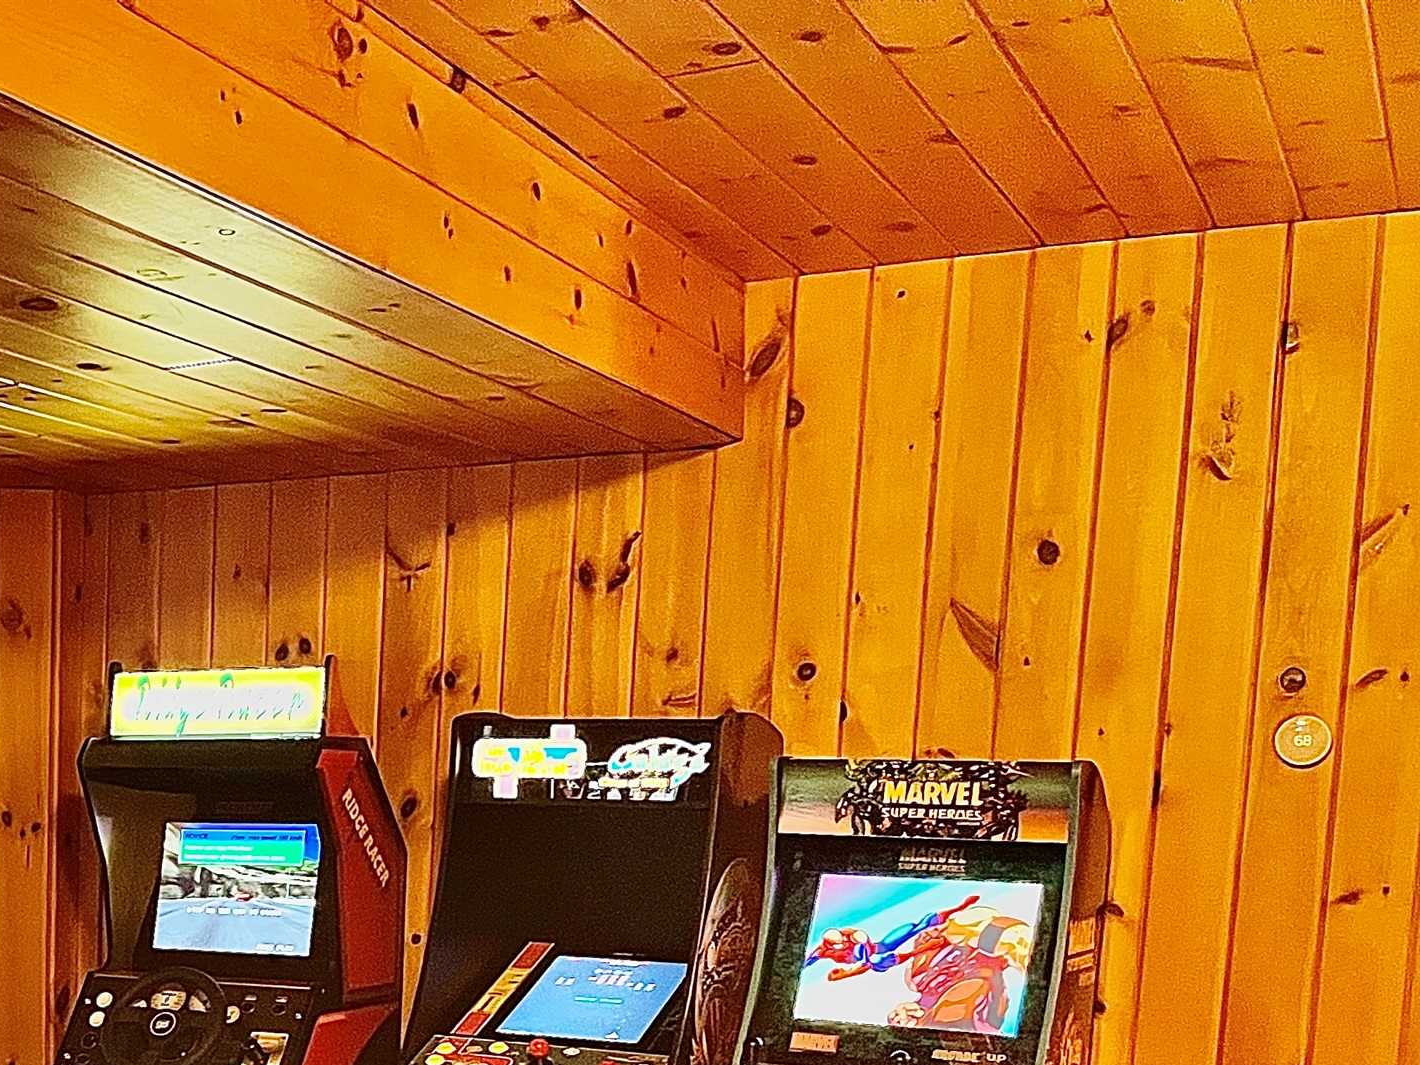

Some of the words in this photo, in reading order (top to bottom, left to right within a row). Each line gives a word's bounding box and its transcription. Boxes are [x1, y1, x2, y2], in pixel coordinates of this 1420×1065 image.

[1294, 734, 1312, 746] 68
[882, 780, 984, 807] MARVEL
[881, 807, 927, 820] SUPER
[928, 808, 983, 822] HEROES
[342, 788, 369, 839] RIDGE
[364, 834, 389, 888] RACER
